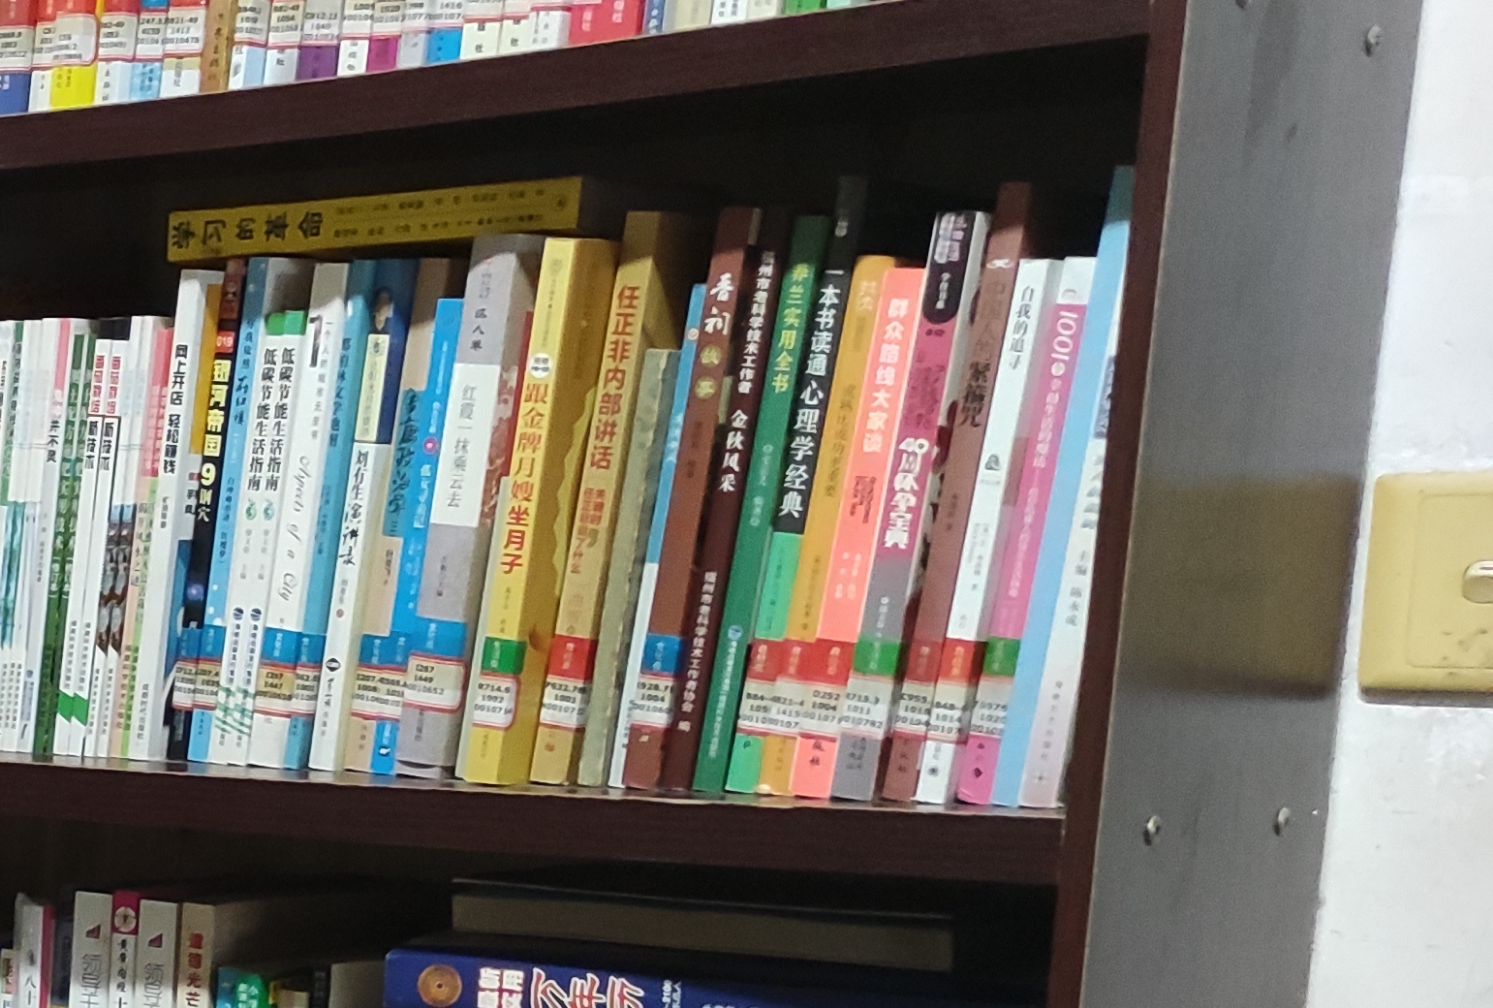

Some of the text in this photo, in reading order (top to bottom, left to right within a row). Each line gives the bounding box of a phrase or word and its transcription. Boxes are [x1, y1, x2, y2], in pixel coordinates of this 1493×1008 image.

[170, 211, 325, 249] 学习的革命
[589, 285, 638, 470] 任正非内部讲话
[770, 262, 810, 394] 养兰实用全书
[778, 268, 843, 517] 一本书读通 心理学经典
[861, 298, 911, 454] 群众路线大家谈
[163, 344, 188, 476] 网上开店 轻松赚钱
[200, 462, 216, 486] 9
[247, 347, 278, 492] 低碳节能生活指南
[265, 347, 297, 492] 低碳节能生活指南
[500, 383, 547, 575] 跟金牌月嫂坐月子
[717, 409, 750, 493] 金秋风采
